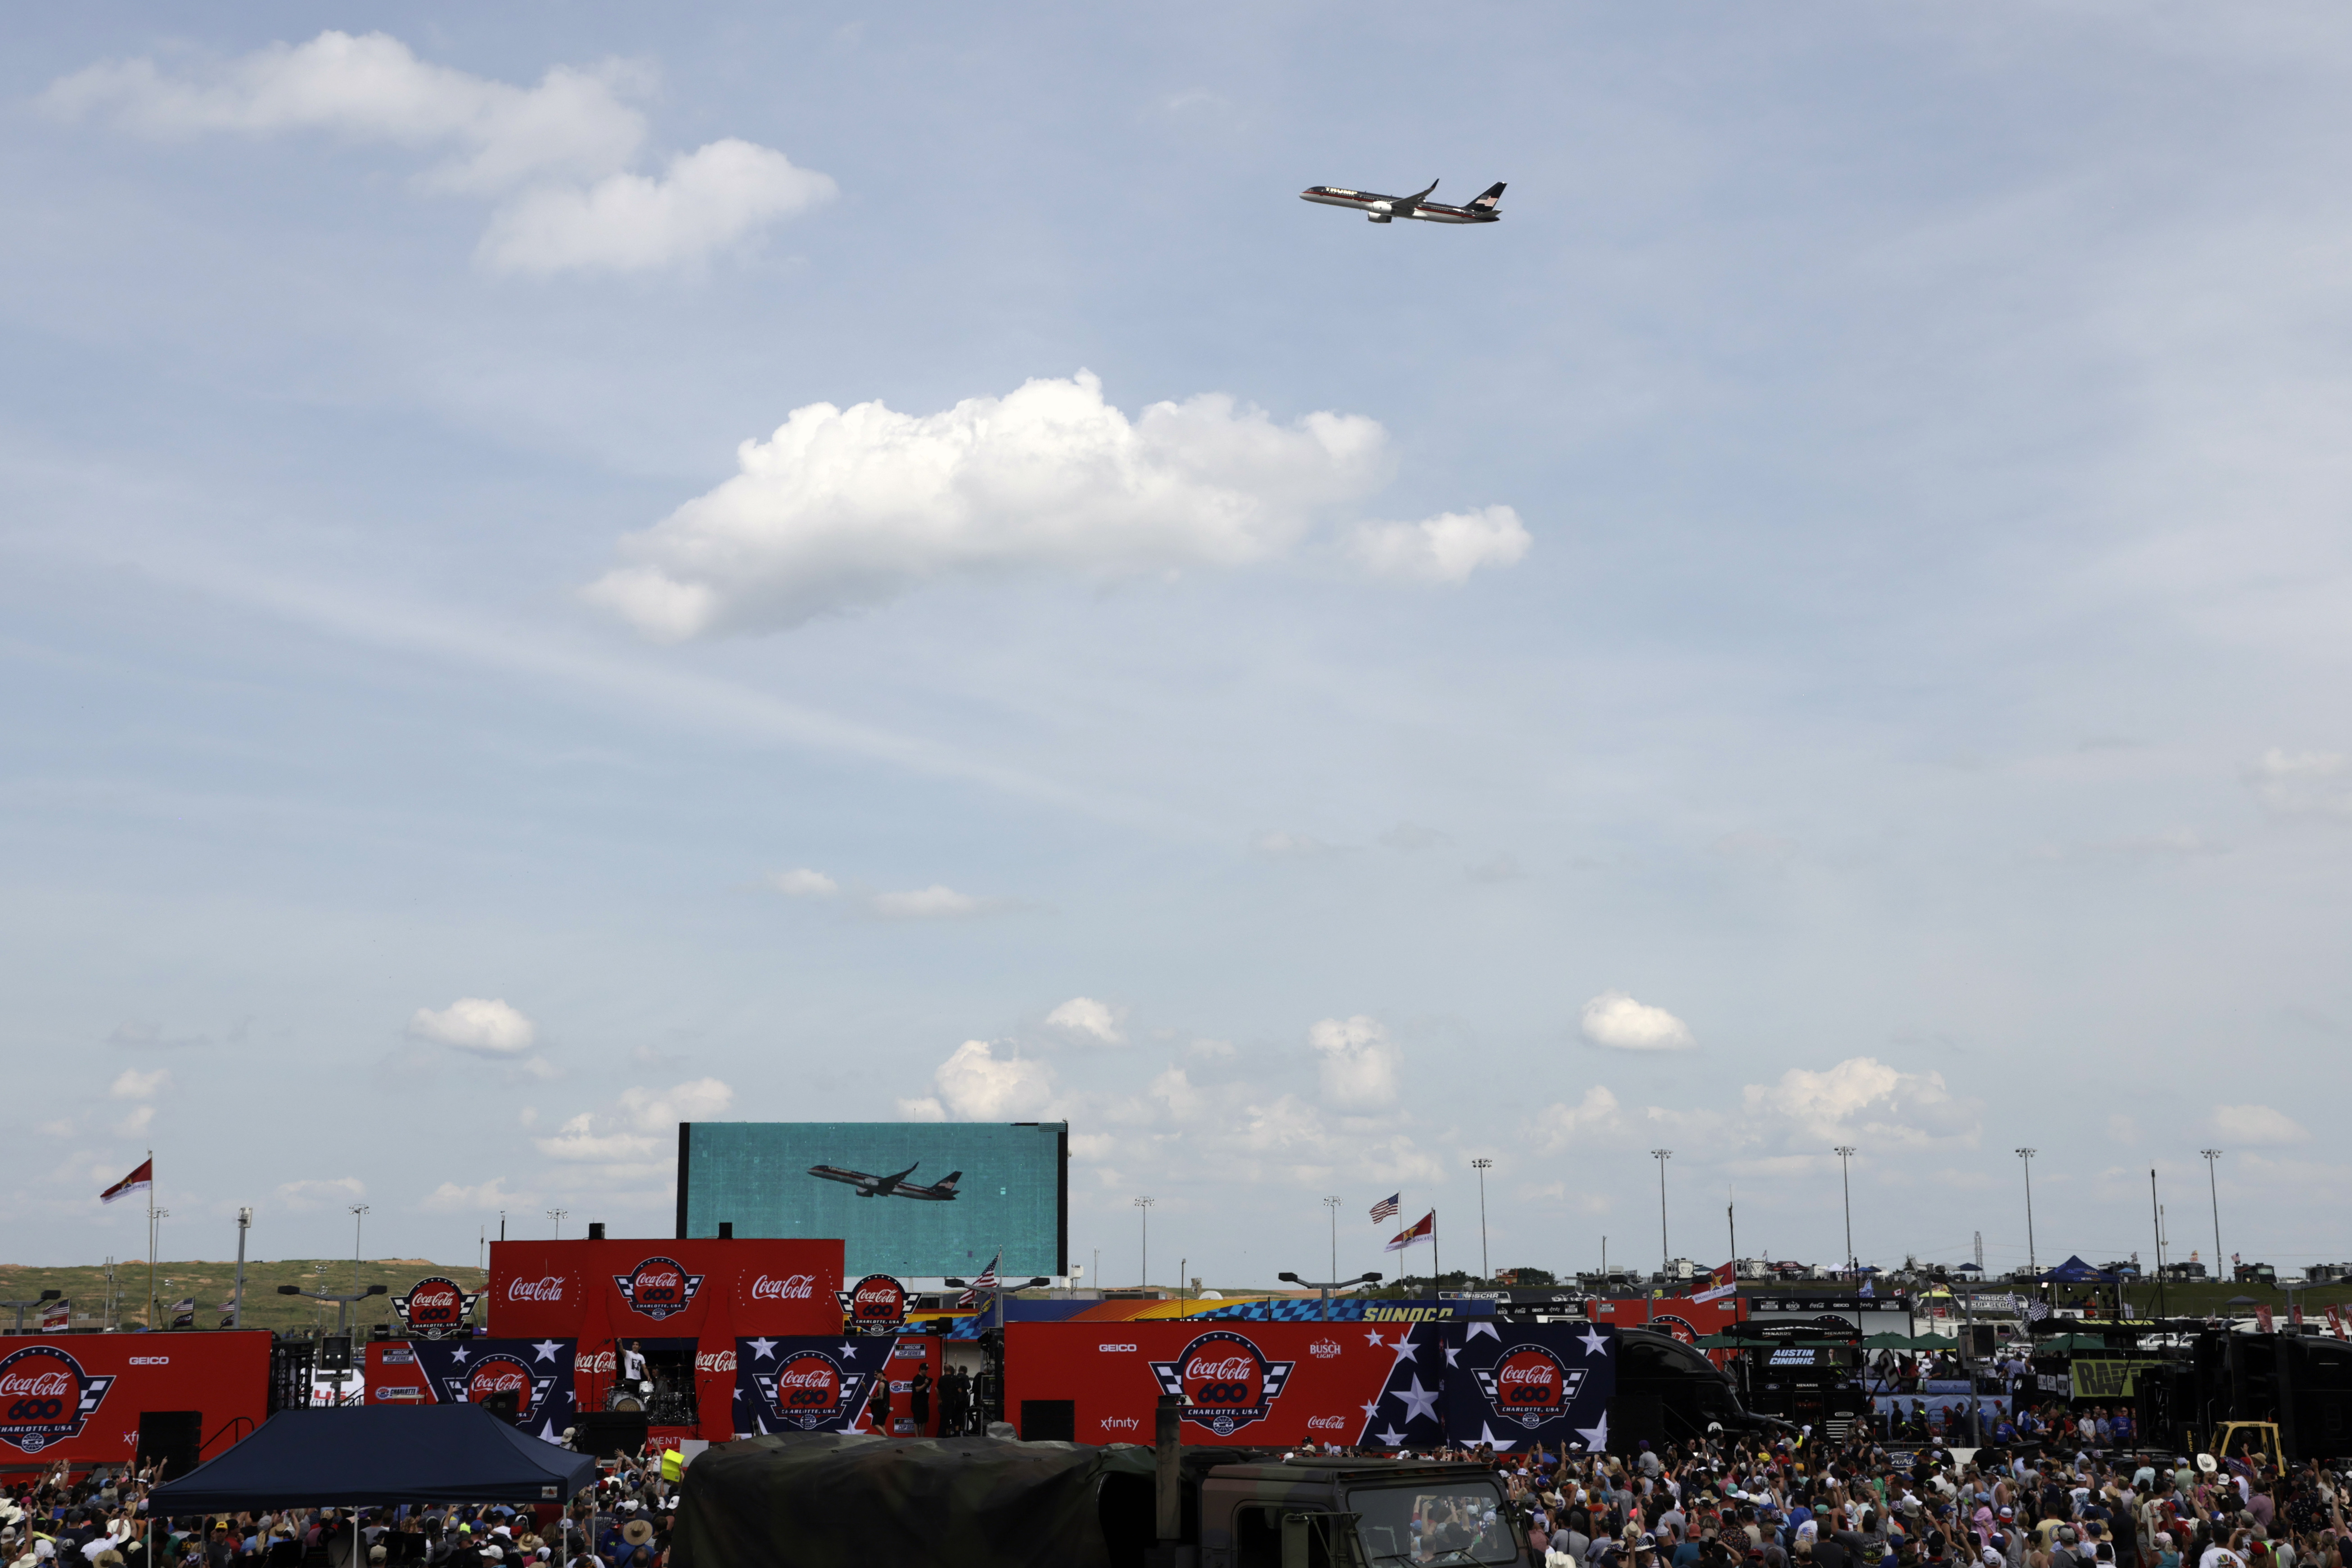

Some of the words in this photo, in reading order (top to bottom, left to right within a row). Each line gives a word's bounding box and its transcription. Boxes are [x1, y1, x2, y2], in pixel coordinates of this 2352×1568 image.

[1325, 186, 1358, 195] TRUMP
[635, 1272, 679, 1287] Coca-Cola
[752, 1274, 817, 1299] Coca-Cola
[508, 1276, 566, 1302] Coca-Cola
[643, 1288, 675, 1301] 600
[856, 1289, 898, 1303] Coca-Cola
[412, 1292, 455, 1307] Coca-Cola
[419, 1307, 450, 1320] 600
[862, 1304, 893, 1316] 600
[1362, 1307, 1454, 1322] SUNOCO
[1099, 1344, 1137, 1352] GEICO
[1310, 1344, 1341, 1355] BUSCH
[129, 1356, 169, 1365] GEICO
[574, 1352, 617, 1373] Coca-Cola
[695, 1350, 737, 1372] Coca-Cola
[1769, 1357, 1815, 1365] CINDRIC
[1185, 1357, 1254, 1380] Coca-Cola
[1500, 1365, 1555, 1384] Coca-Cola
[1879, 1349, 1901, 1391] 2
[0, 1372, 73, 1397] Coca-Cola
[471, 1374, 525, 1392] Coca-Cola
[781, 1370, 834, 1388] Coca-Cola
[789, 1389, 828, 1405] 600
[1198, 1383, 1248, 1403] 600
[1510, 1386, 1550, 1402] 600
[8, 1398, 63, 1420] 600
[1100, 1416, 1139, 1431] xfinity
[1307, 1415, 1346, 1429] Coca-Cola
